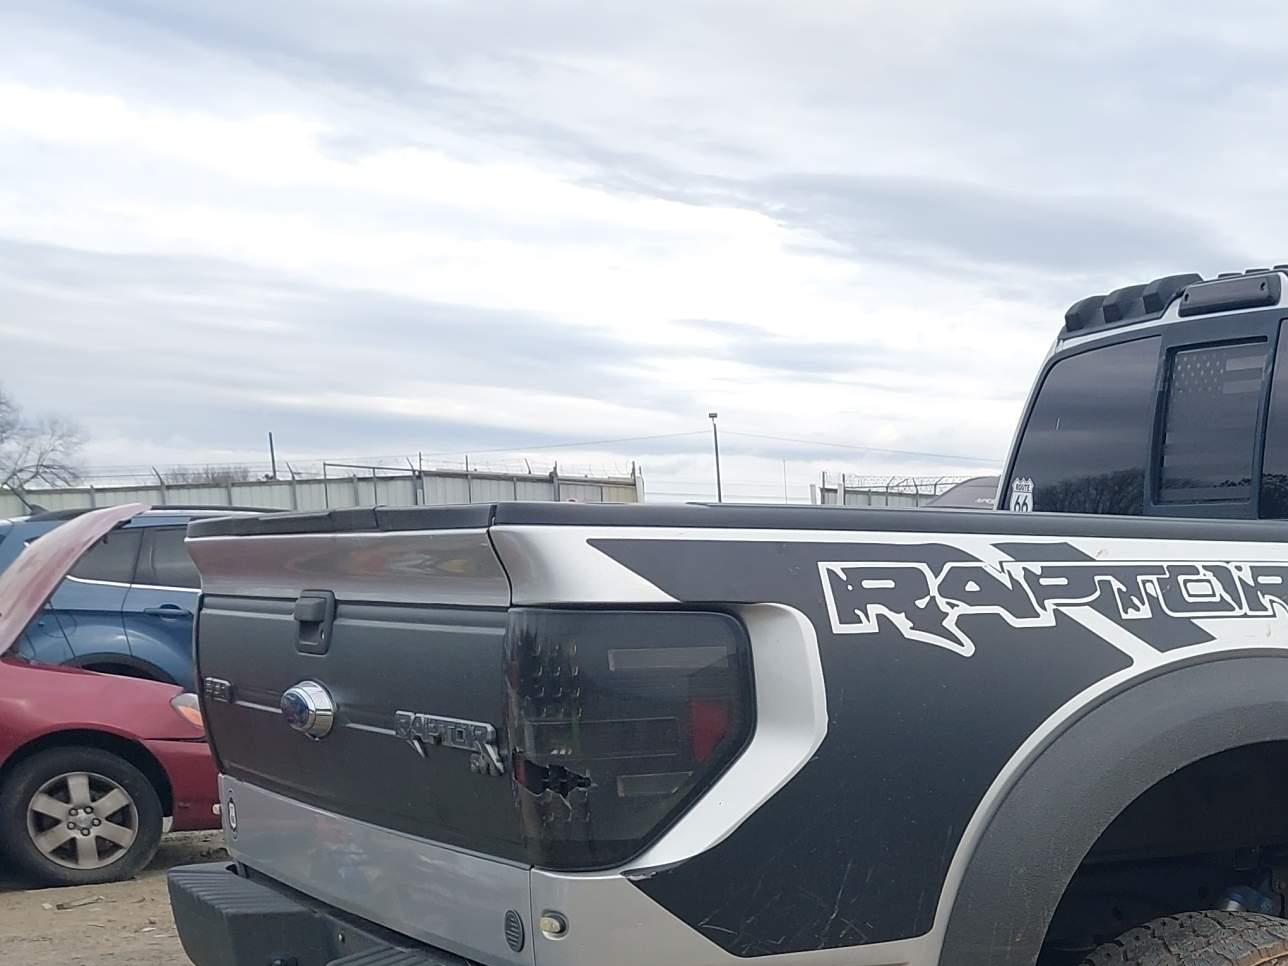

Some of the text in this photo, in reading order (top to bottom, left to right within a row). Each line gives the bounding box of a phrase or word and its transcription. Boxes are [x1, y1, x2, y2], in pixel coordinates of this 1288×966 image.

[1015, 483, 1031, 491] ROUTE
[1013, 494, 1029, 512] 66
[394, 709, 505, 774] RAPTOR
